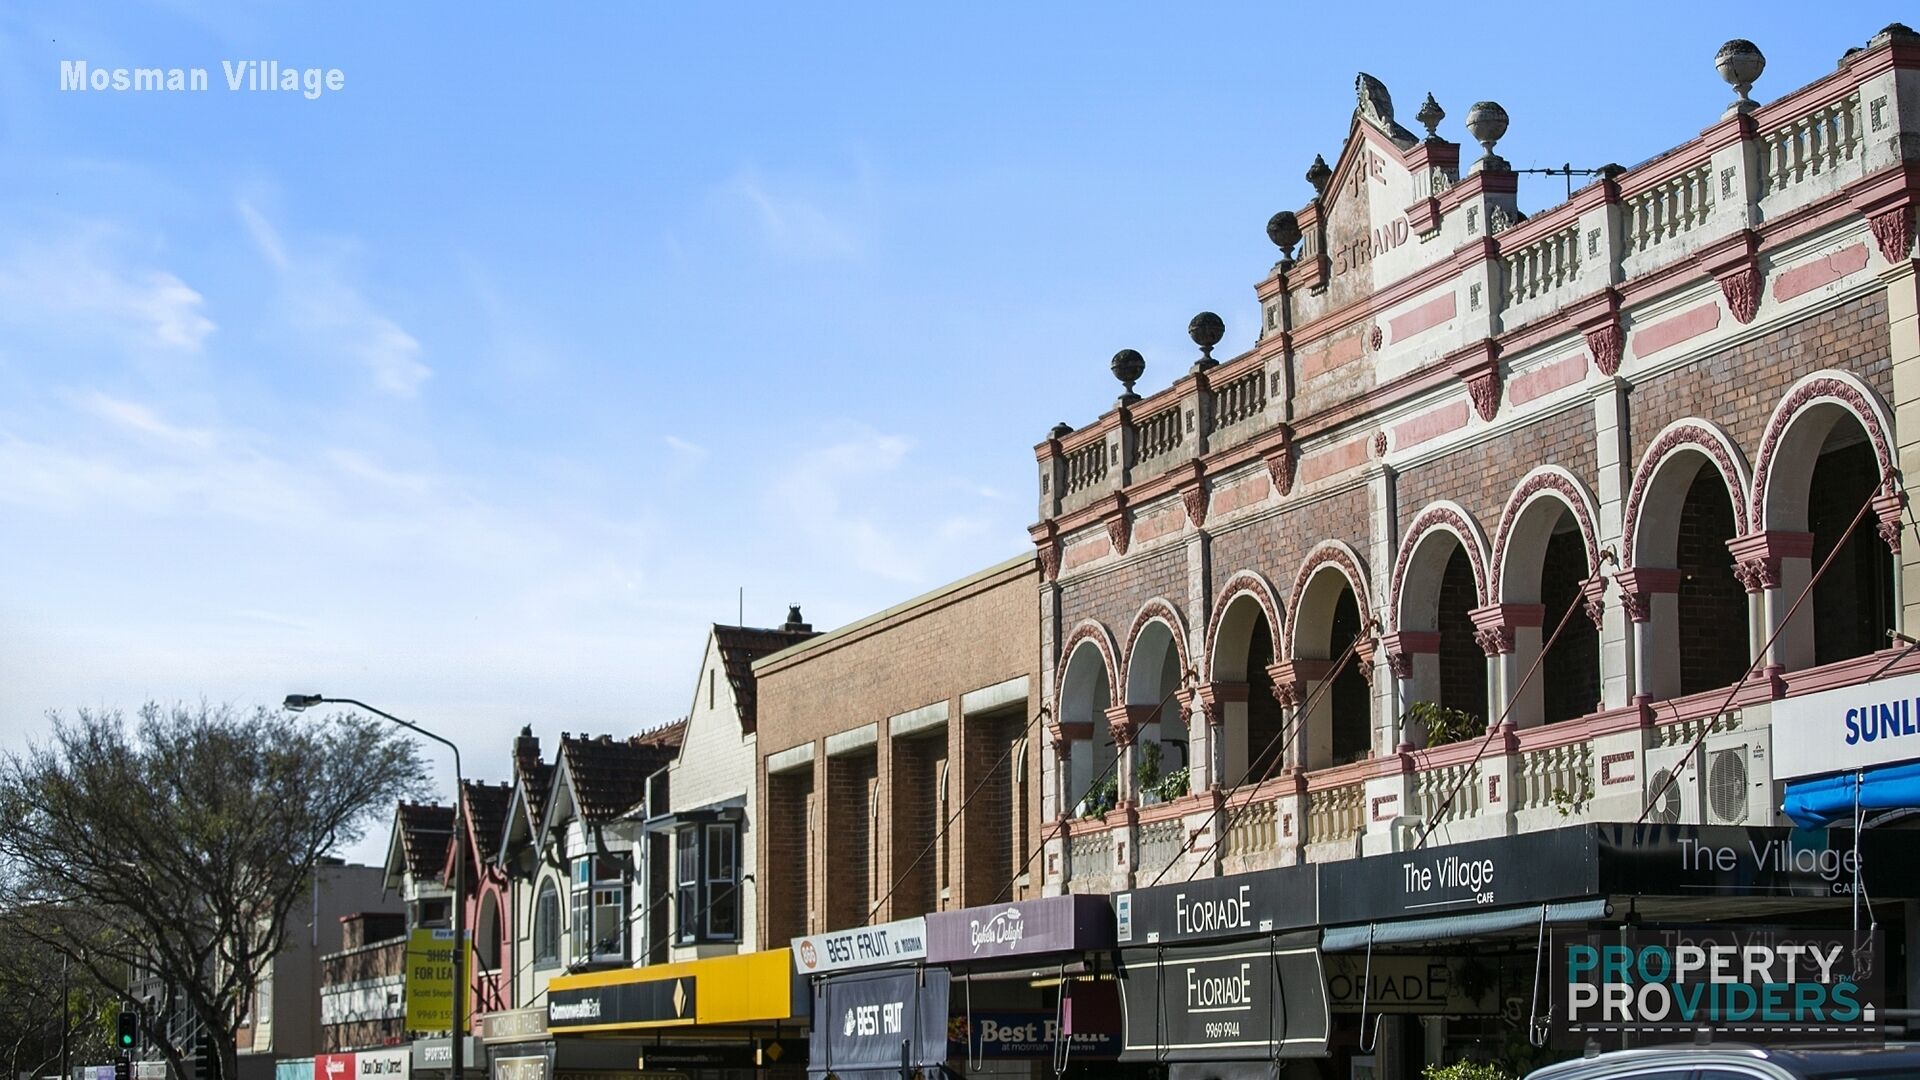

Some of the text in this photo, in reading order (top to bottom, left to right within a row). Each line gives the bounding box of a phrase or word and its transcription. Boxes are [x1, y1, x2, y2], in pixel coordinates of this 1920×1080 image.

[1350, 149, 1386, 198] THE
[1335, 216, 1409, 276] STRAND
[1403, 856, 1494, 893] The Village
[1677, 838, 1863, 881] The Village
[1177, 885, 1251, 934] FLORIADE
[1476, 892, 1494, 904] CAFE
[826, 935, 855, 963] BEST
[857, 930, 890, 960] FRUIT
[414, 967, 453, 980] FOR LEA
[1187, 963, 1251, 1006] FLORIADE
[856, 1002, 904, 1036] BEST FRUIT
[980, 1020, 1037, 1042] Best
[1205, 1021, 1240, 1038] 9969 9944
